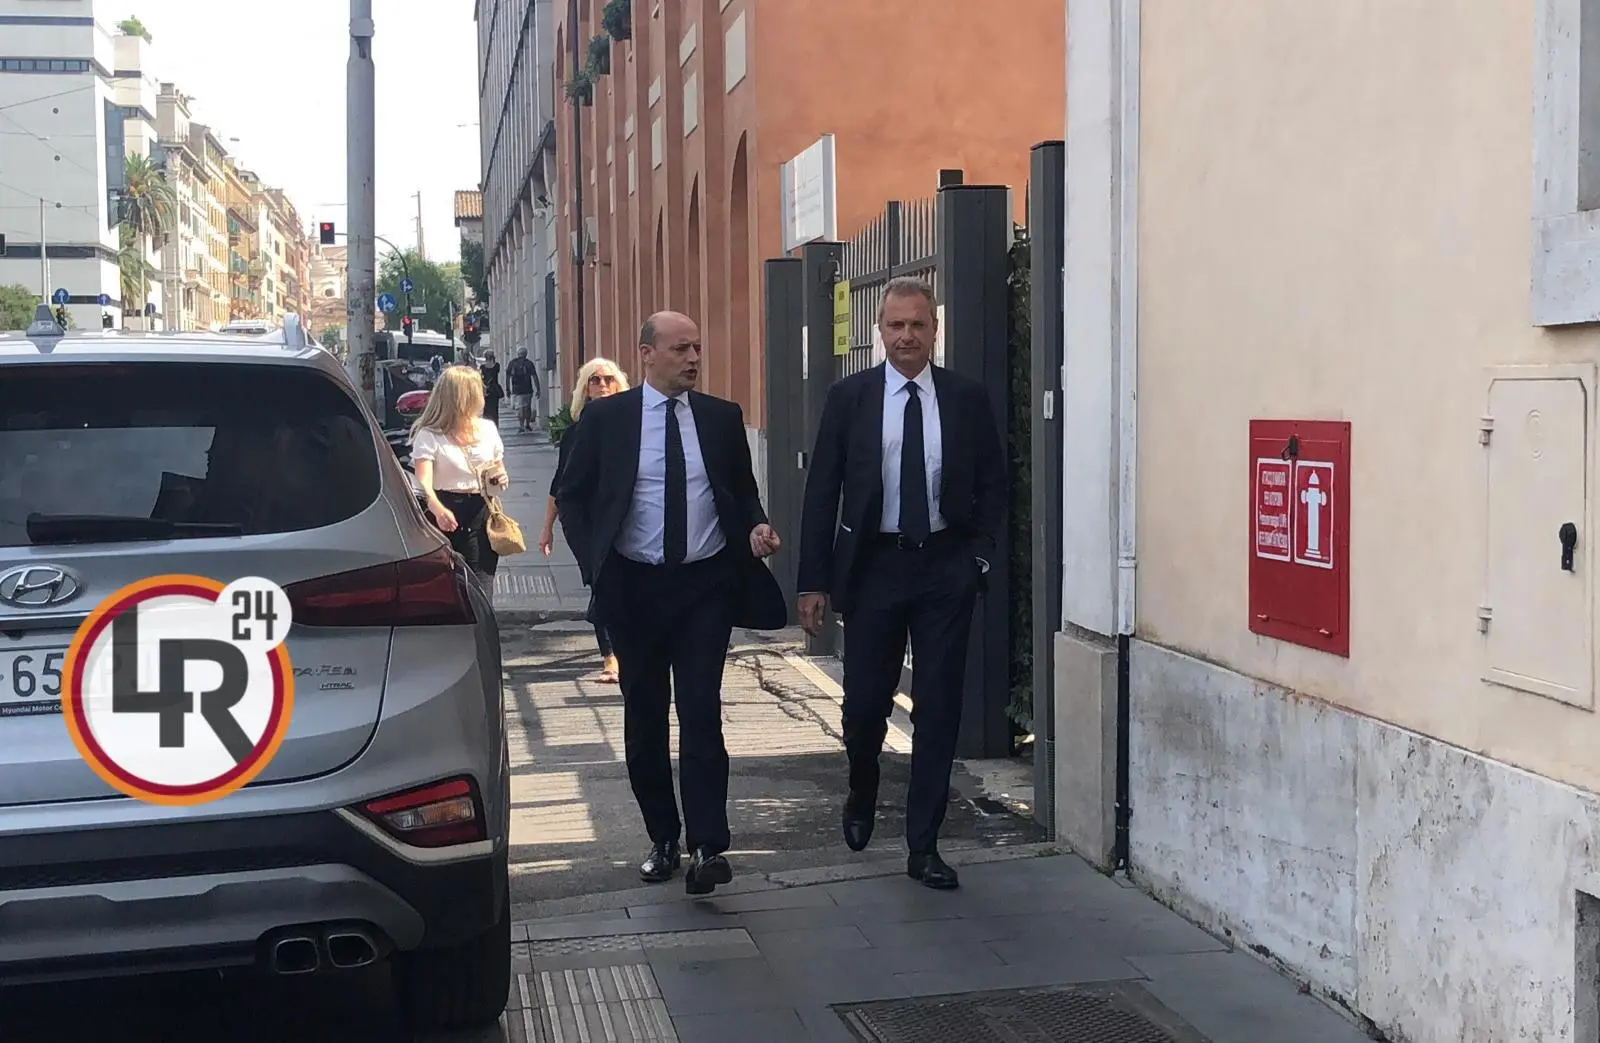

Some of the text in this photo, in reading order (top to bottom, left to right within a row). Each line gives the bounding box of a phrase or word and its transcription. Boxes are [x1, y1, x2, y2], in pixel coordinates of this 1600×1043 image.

[12, 652, 64, 697] 65
[2, 705, 31, 714] Hyundai
[32, 704, 53, 712] Motor
